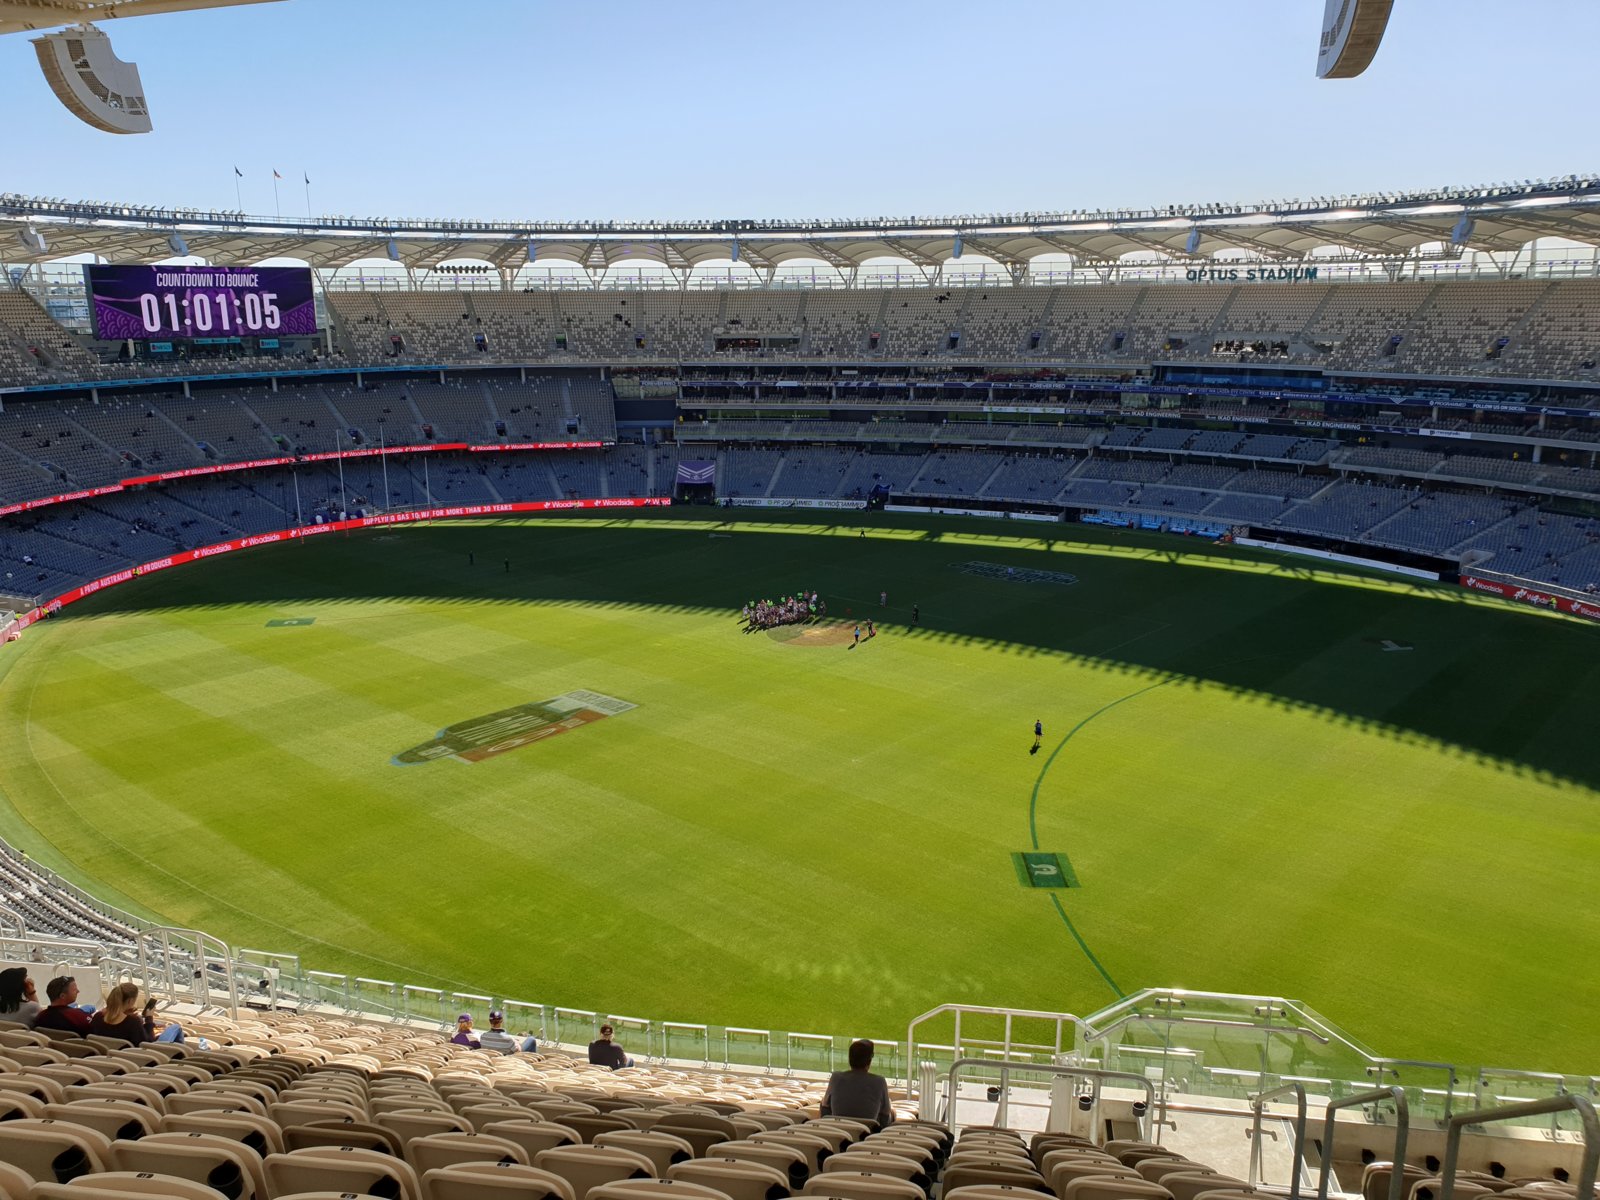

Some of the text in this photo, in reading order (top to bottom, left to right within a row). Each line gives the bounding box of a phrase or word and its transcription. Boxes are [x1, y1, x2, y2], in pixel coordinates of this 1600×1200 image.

[156, 273, 259, 287] COUNTDOWN TO BOUNCE
[1186, 267, 1318, 281] OPTUS STADIUM
[140, 293, 281, 332] 01:01:05
[397, 513, 410, 521] GAS
[432, 509, 444, 517] FOR
[446, 508, 464, 516] MORE
[465, 506, 481, 514] THAN
[493, 504, 513, 512] YEARS
[299, 525, 330, 535] Woodside
[249, 534, 280, 545] Woodside
[200, 544, 232, 556] Woodside
[84, 581, 99, 594] PROUD
[100, 570, 132, 587] AUSTRALIAN
[143, 558, 172, 573] PRODUCER
[1475, 582, 1503, 594] Woodside
